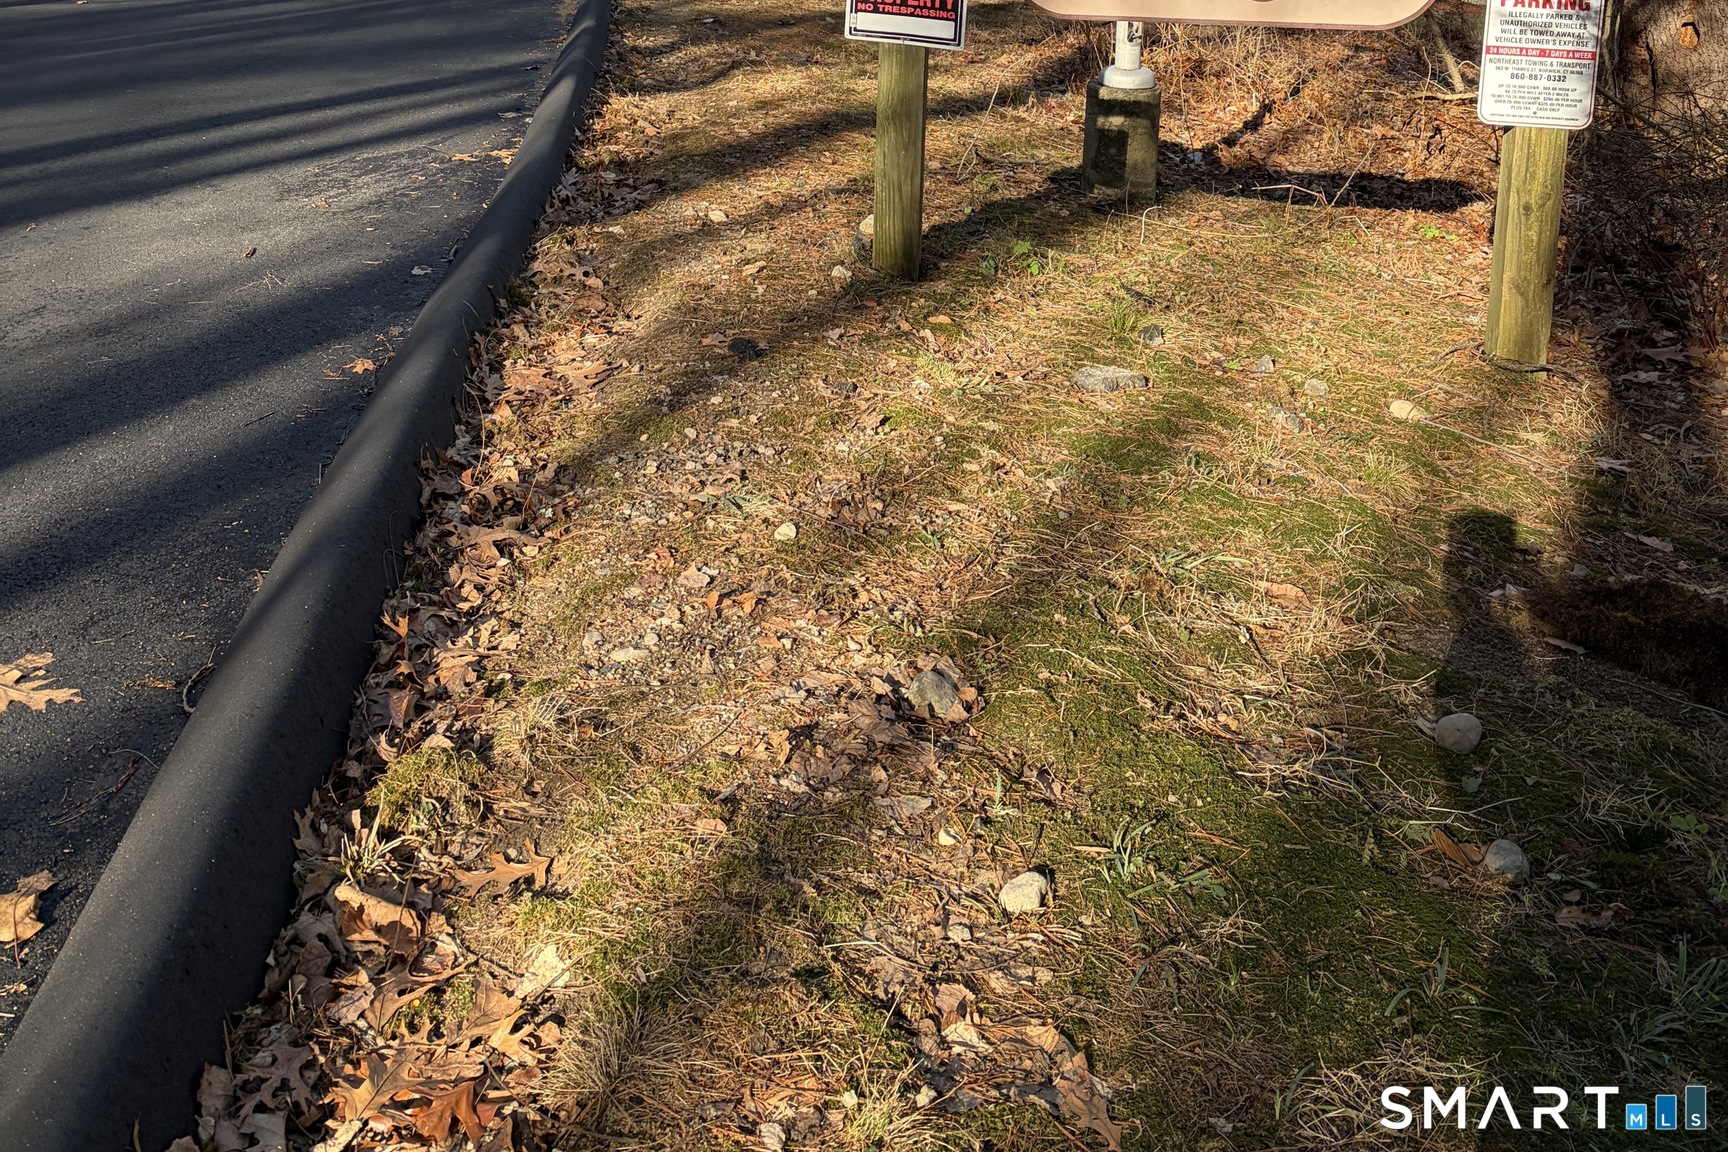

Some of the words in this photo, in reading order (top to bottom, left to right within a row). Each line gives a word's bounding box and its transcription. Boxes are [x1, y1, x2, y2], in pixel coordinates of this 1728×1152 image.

[857, 3, 874, 11] NO
[877, 4, 956, 19] TRESPASSING
[1500, 19, 1552, 28] UNAUTHORIZED
[1510, 73, 1567, 82] 860-887-0332
